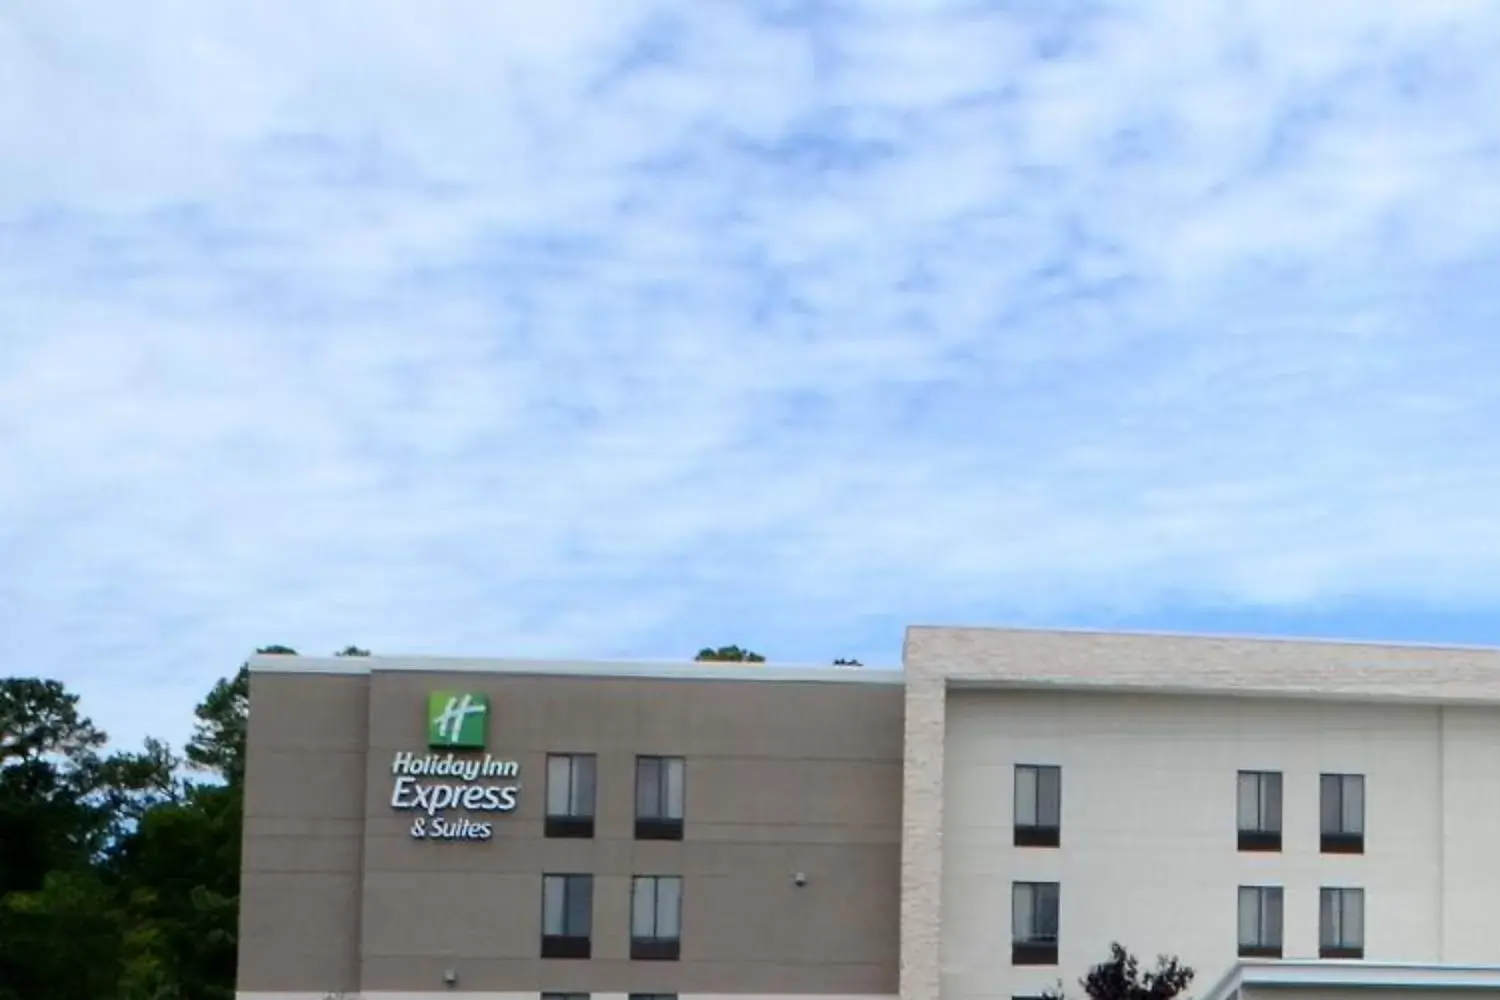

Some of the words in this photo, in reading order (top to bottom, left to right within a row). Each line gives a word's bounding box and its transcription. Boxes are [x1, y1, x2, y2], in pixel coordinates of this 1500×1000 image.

[392, 752, 480, 781] Holiday
[482, 754, 519, 777] Inn
[391, 776, 517, 815] Express
[411, 817, 425, 838] &
[429, 817, 492, 838] Suites
